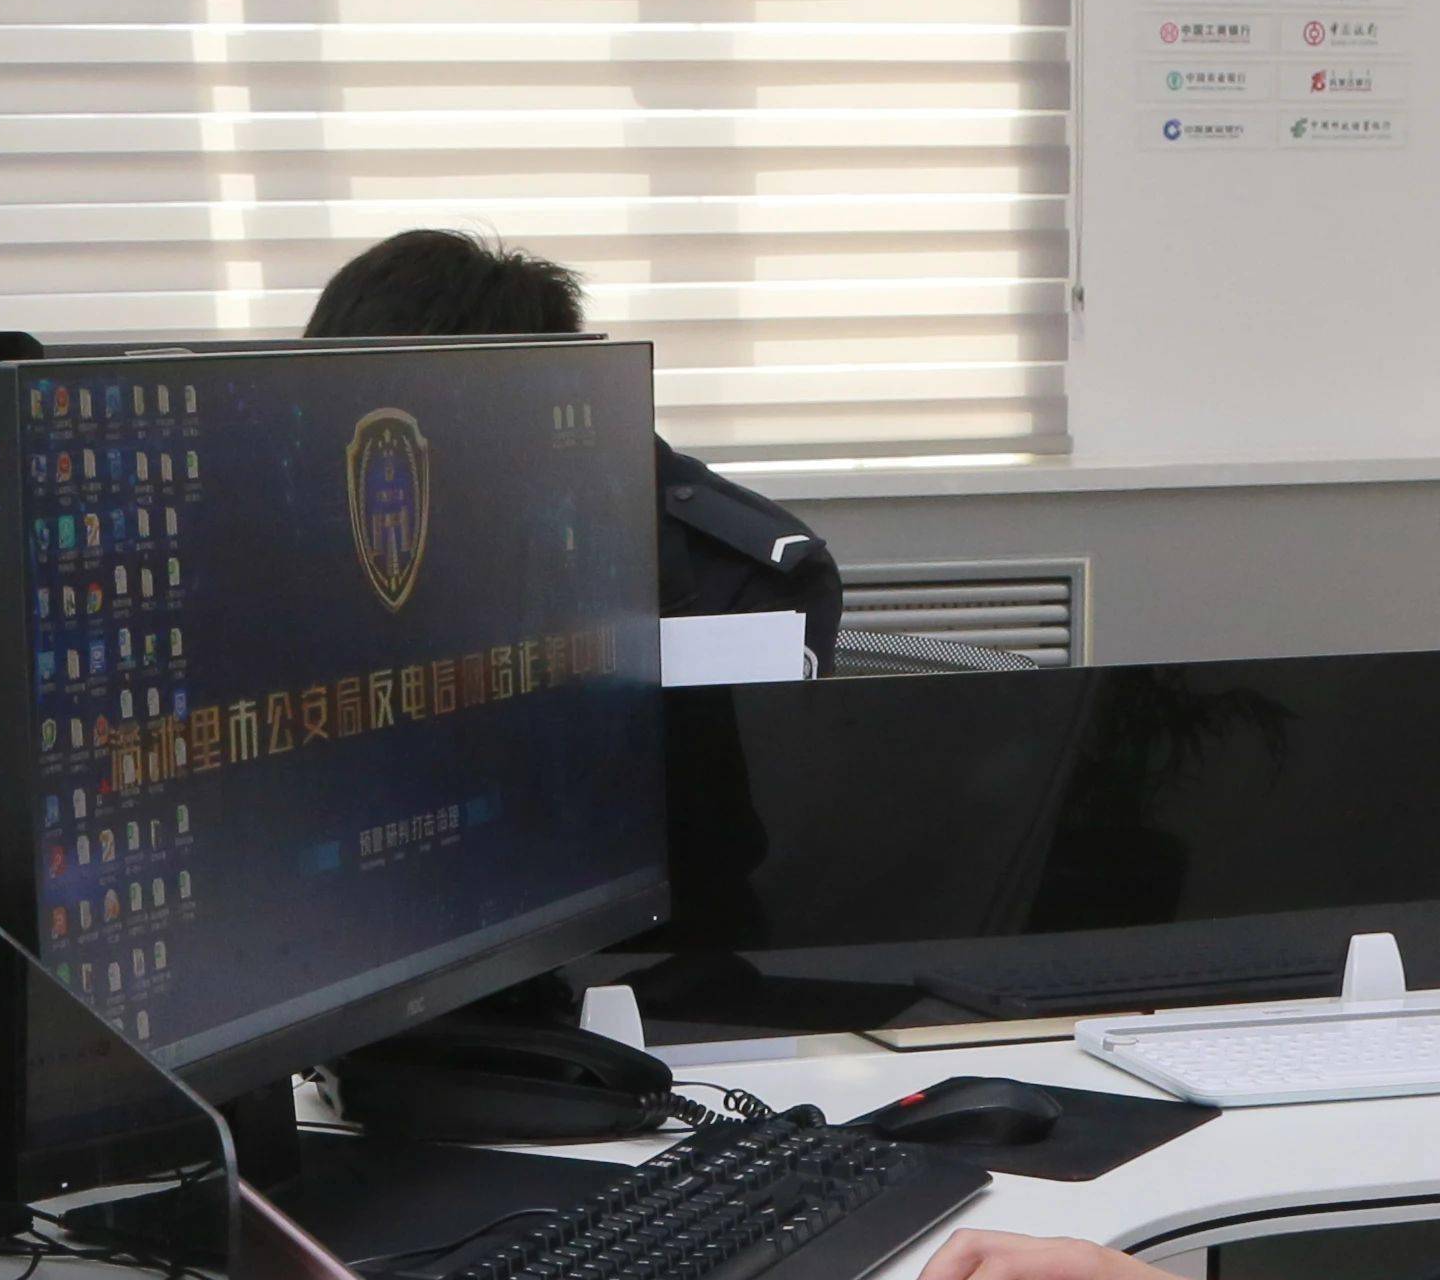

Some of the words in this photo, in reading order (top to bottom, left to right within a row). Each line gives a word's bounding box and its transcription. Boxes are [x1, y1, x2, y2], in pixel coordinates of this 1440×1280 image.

[1181, 24, 1250, 36] 中国工商银行
